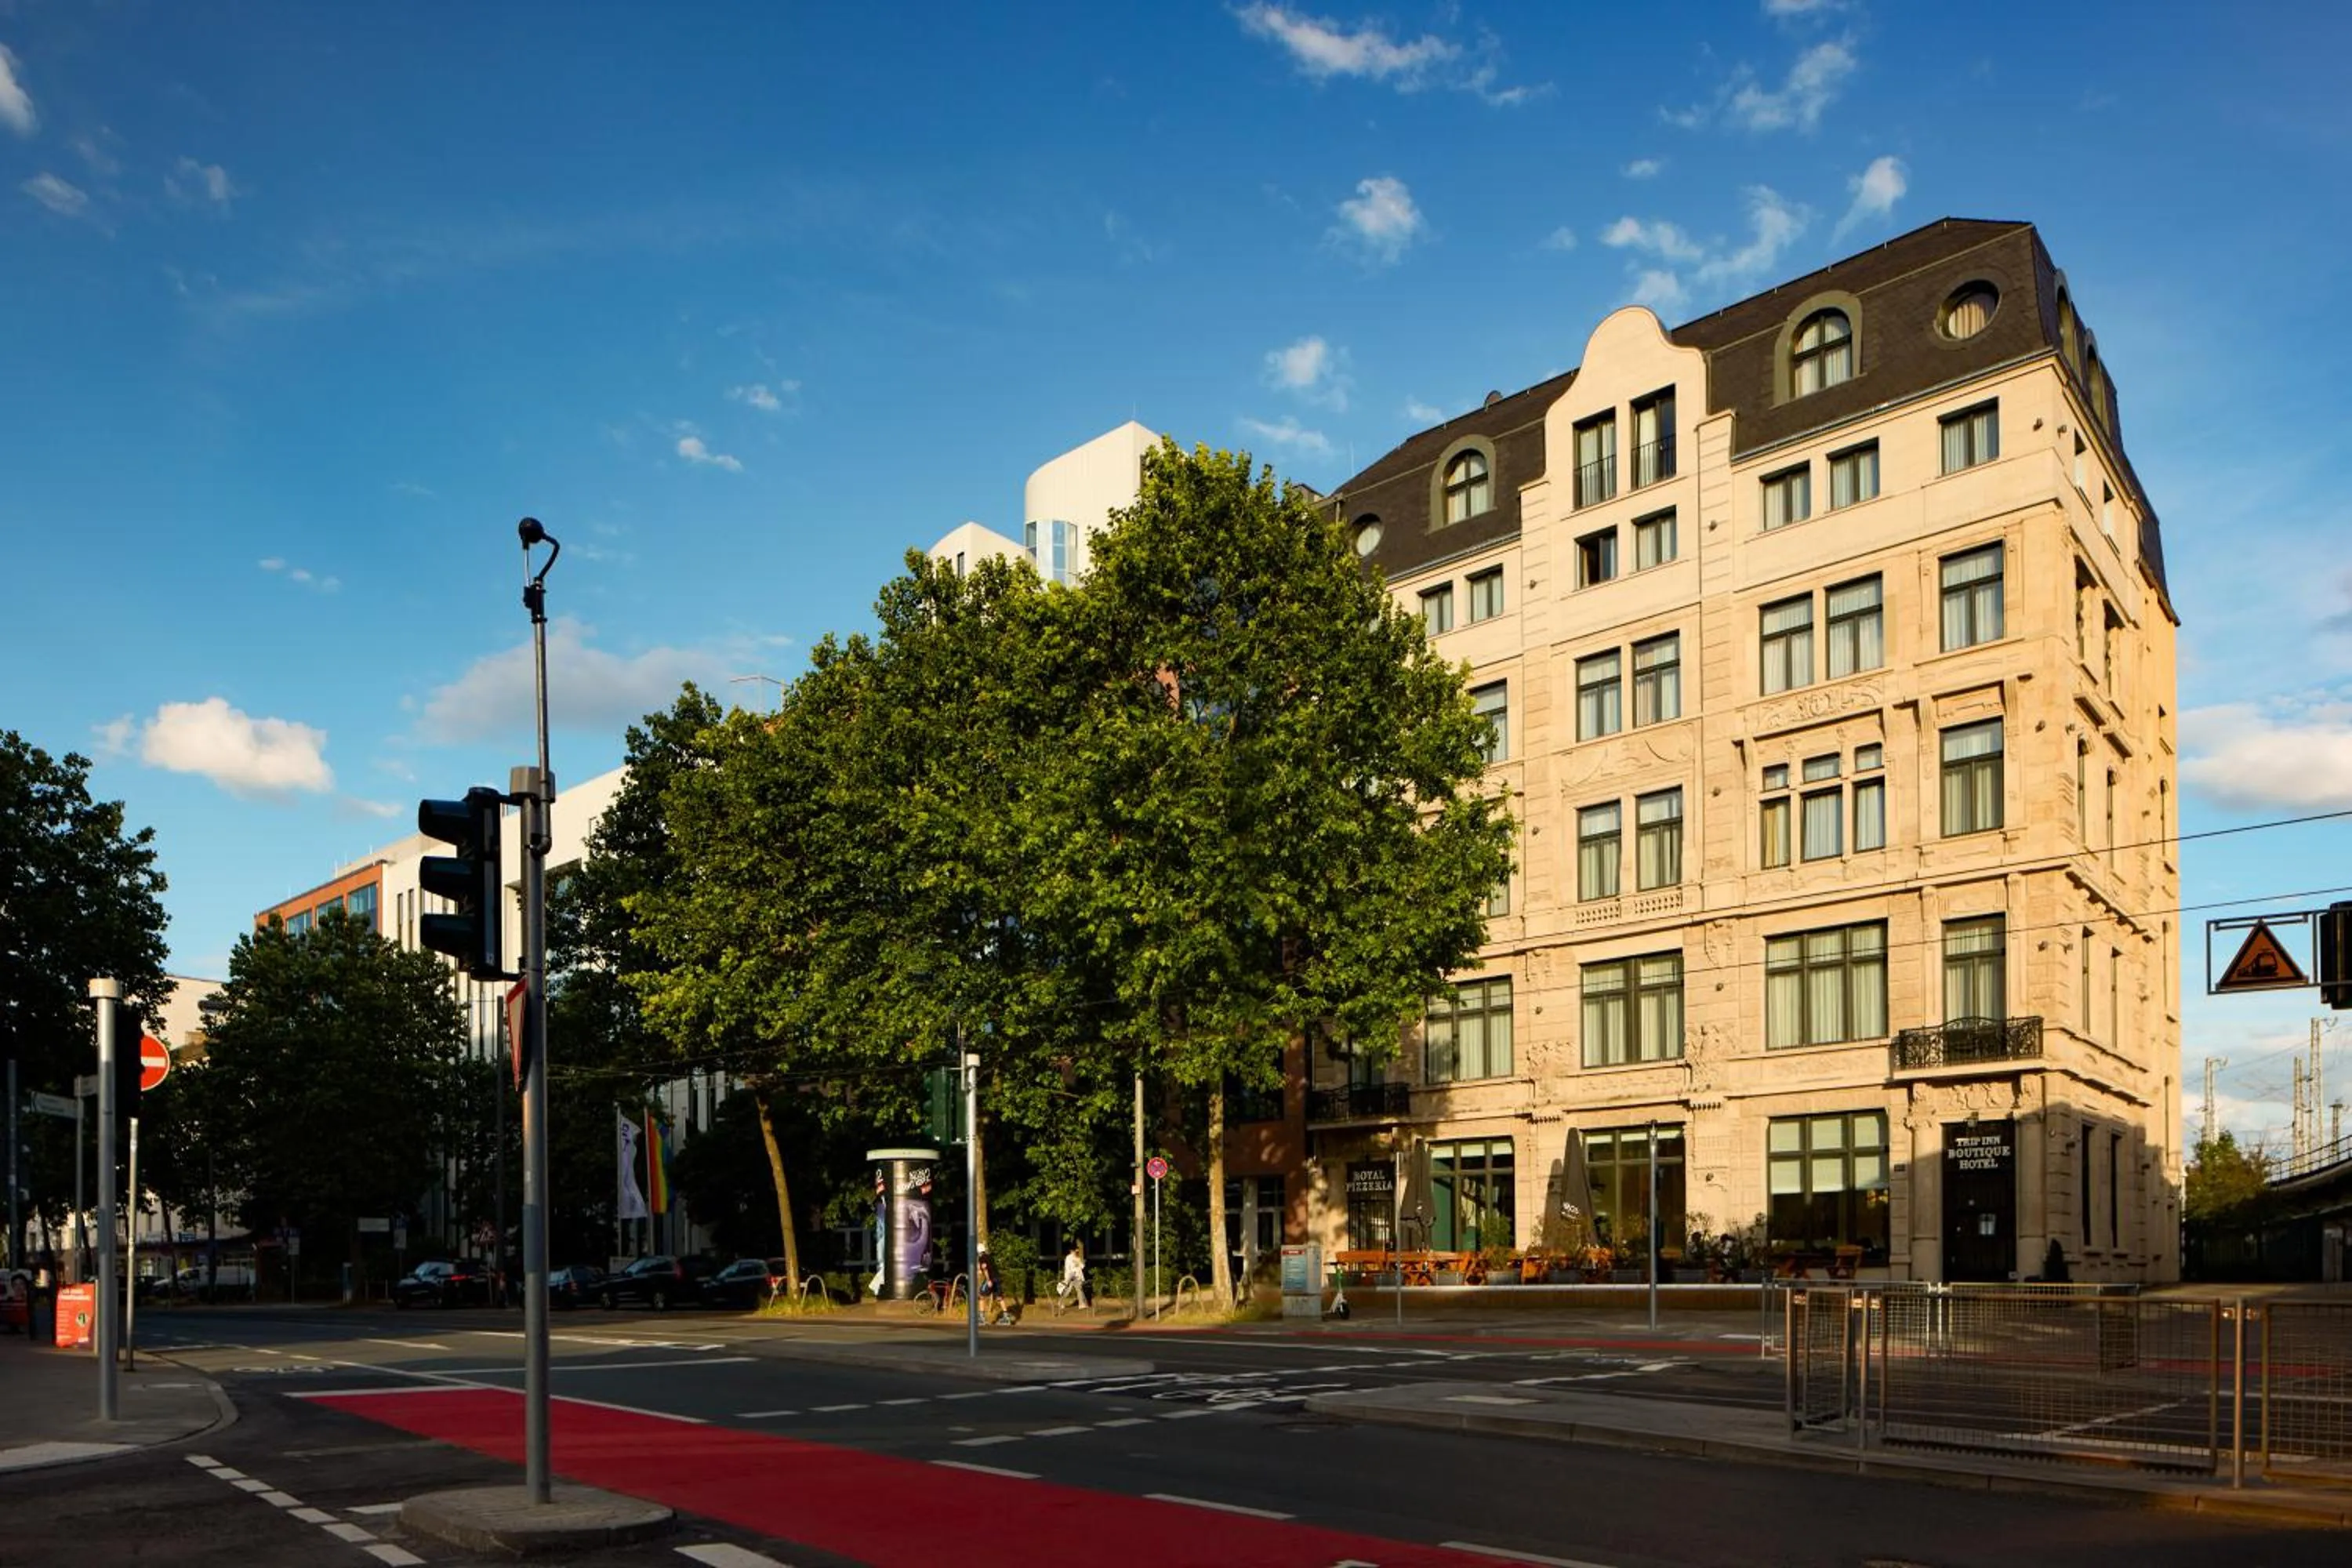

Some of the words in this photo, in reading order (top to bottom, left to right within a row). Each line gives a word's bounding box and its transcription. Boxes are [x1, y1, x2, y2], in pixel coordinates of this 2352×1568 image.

[1955, 1137, 1980, 1147] TRIP
[1981, 1135, 2002, 1145] INN
[1947, 1145, 2011, 1159] BOUTIQUE
[1958, 1159, 1998, 1170] HOTEL
[1352, 1170, 1385, 1181] ROYAL
[1345, 1180, 1393, 1192] PIZZERIA
